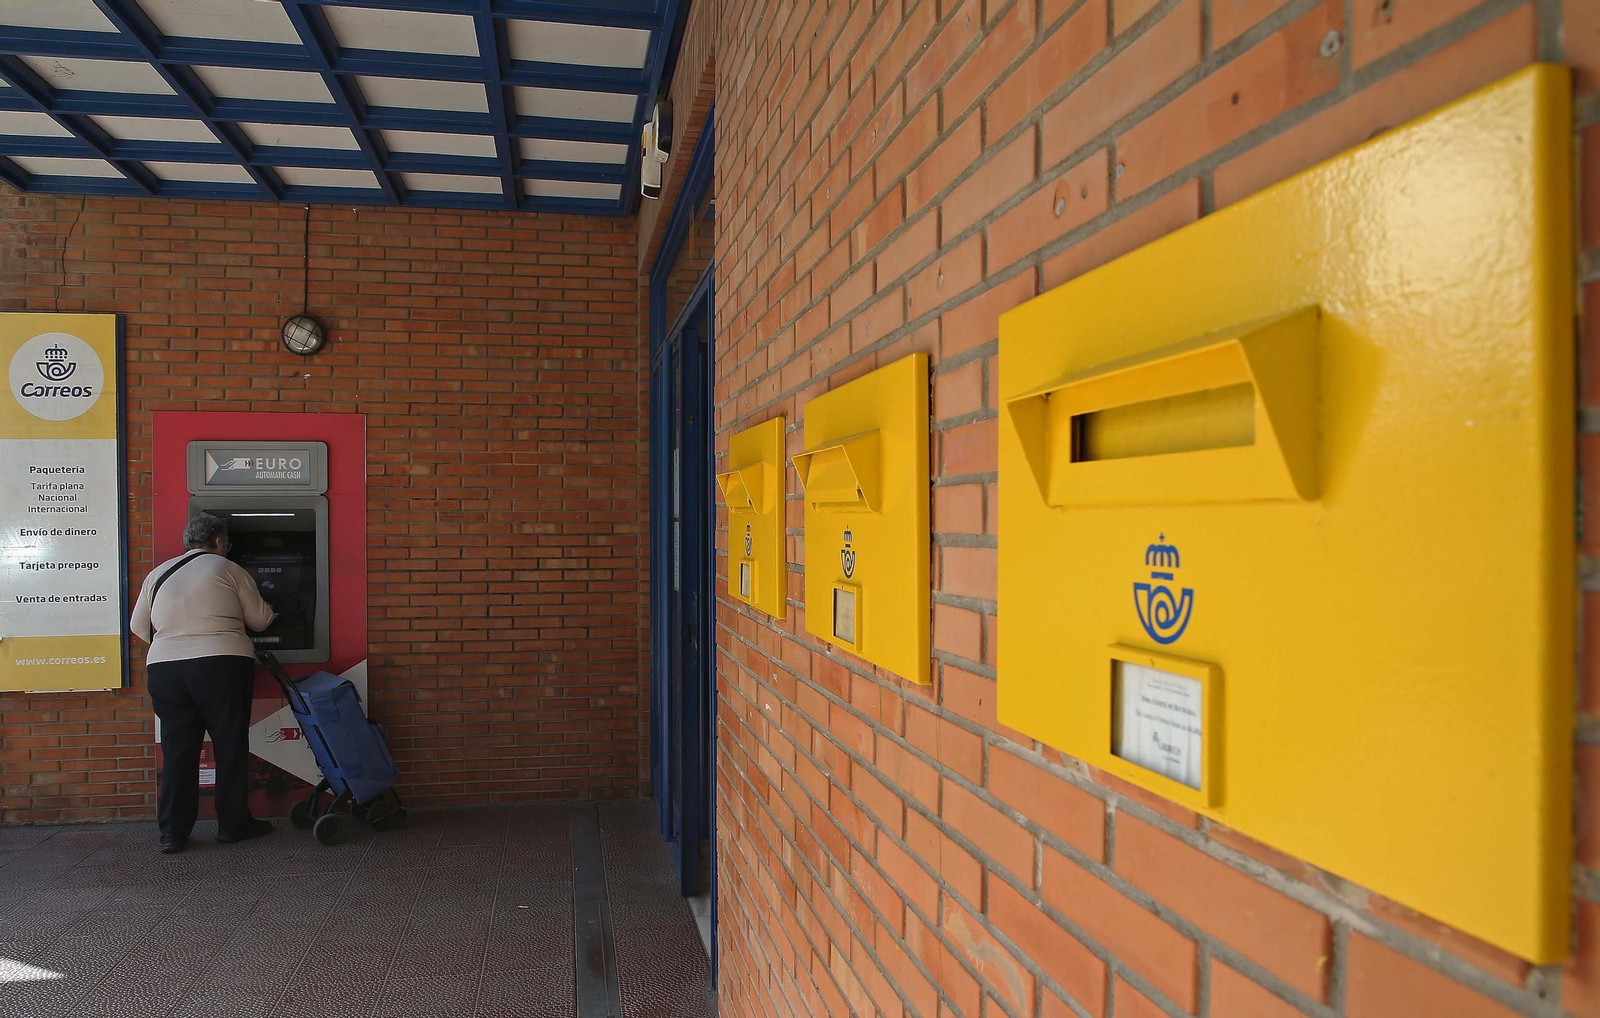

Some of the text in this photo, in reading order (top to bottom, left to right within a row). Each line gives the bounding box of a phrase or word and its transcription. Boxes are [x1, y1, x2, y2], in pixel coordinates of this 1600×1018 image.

[20, 382, 93, 398] Correos
[255, 457, 302, 470] EURO
[29, 465, 85, 475] Paquetería
[255, 471, 301, 479] AUTOMATIC CASH
[30, 482, 85, 492] Tarifa plana
[38, 493, 77, 502] Nacional
[27, 505, 88, 513] Internacional
[20, 527, 97, 537] Envío de dinero
[19, 561, 99, 571] Tarjeta prepago
[15, 593, 108, 604] Venta de entradas
[15, 656, 106, 666] www.correos.es
